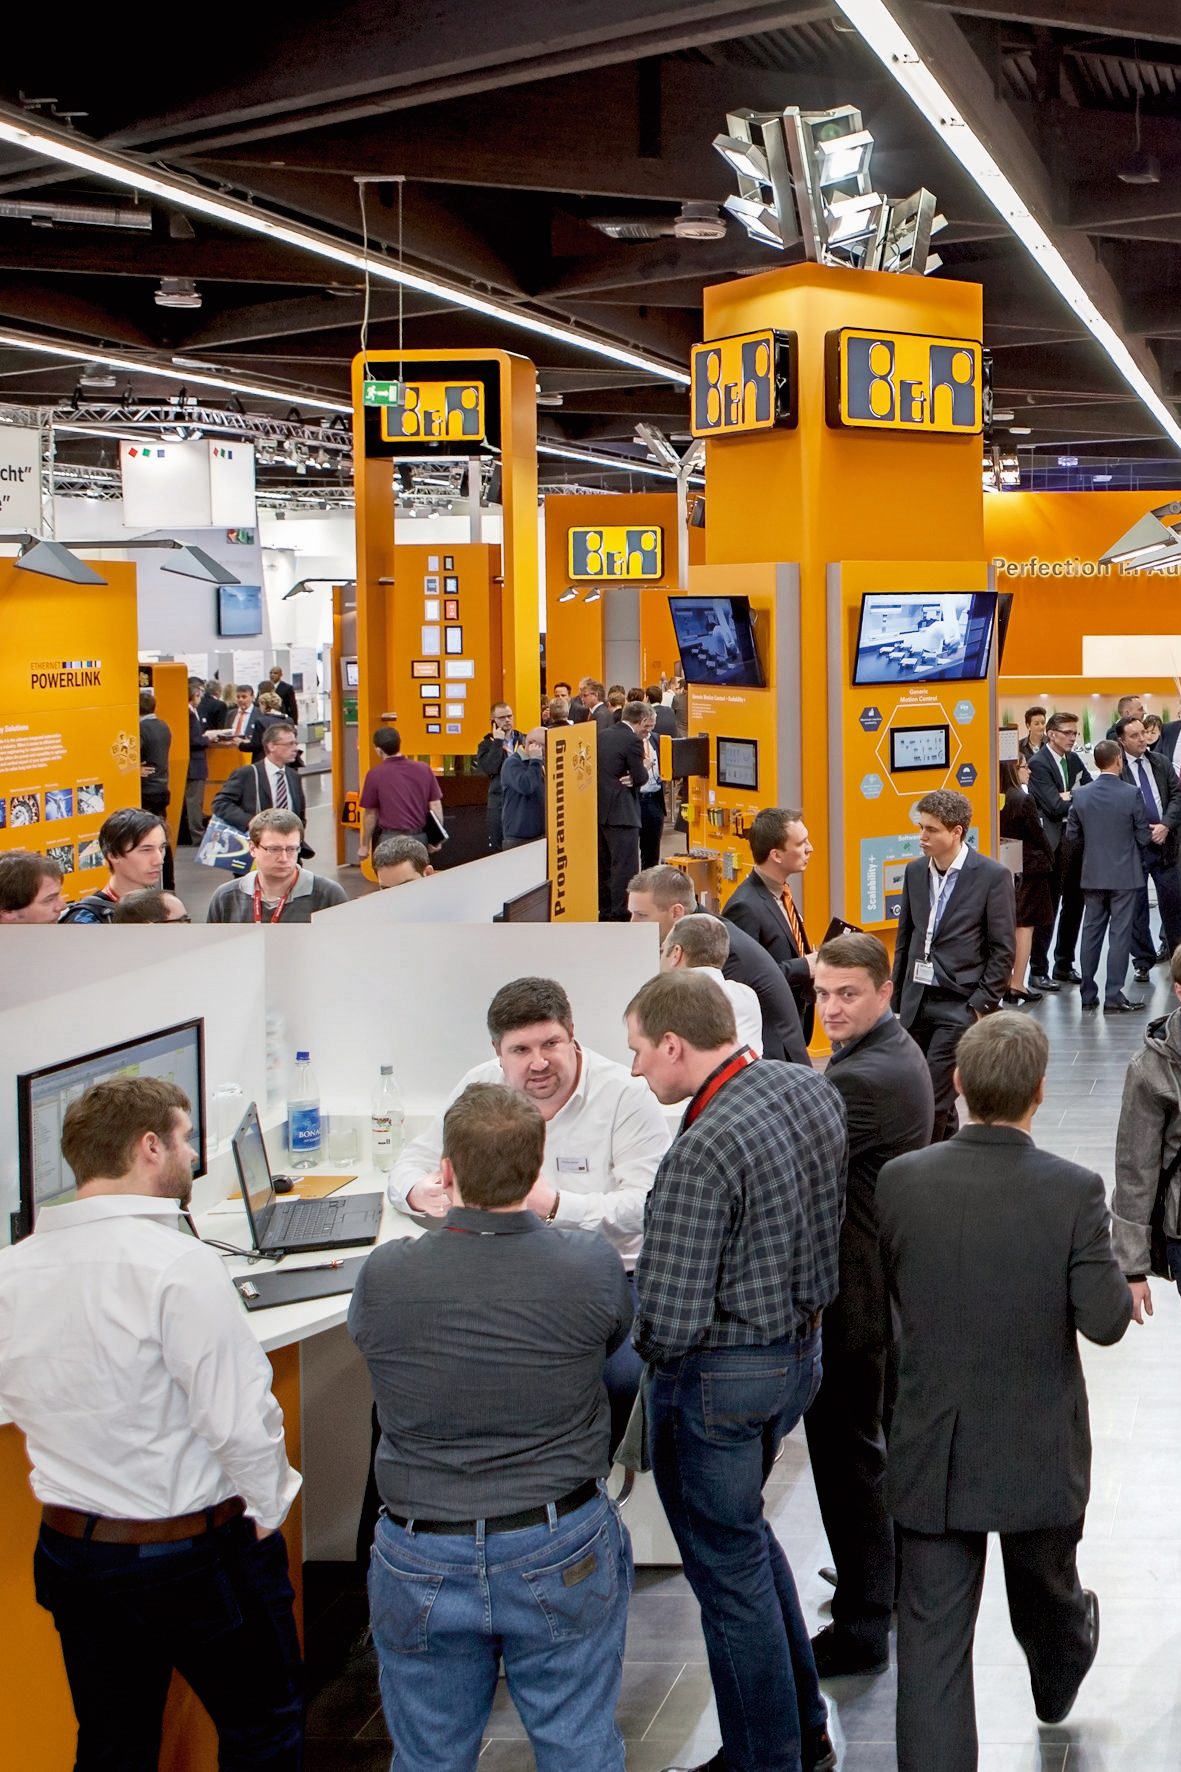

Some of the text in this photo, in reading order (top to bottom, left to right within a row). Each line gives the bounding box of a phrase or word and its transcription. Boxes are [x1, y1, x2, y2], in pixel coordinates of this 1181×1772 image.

[992, 557, 1111, 577] Perfection
[31, 661, 61, 670] ETHERNET
[31, 671, 101, 689] POWERLINK
[552, 738, 569, 917] Programming
